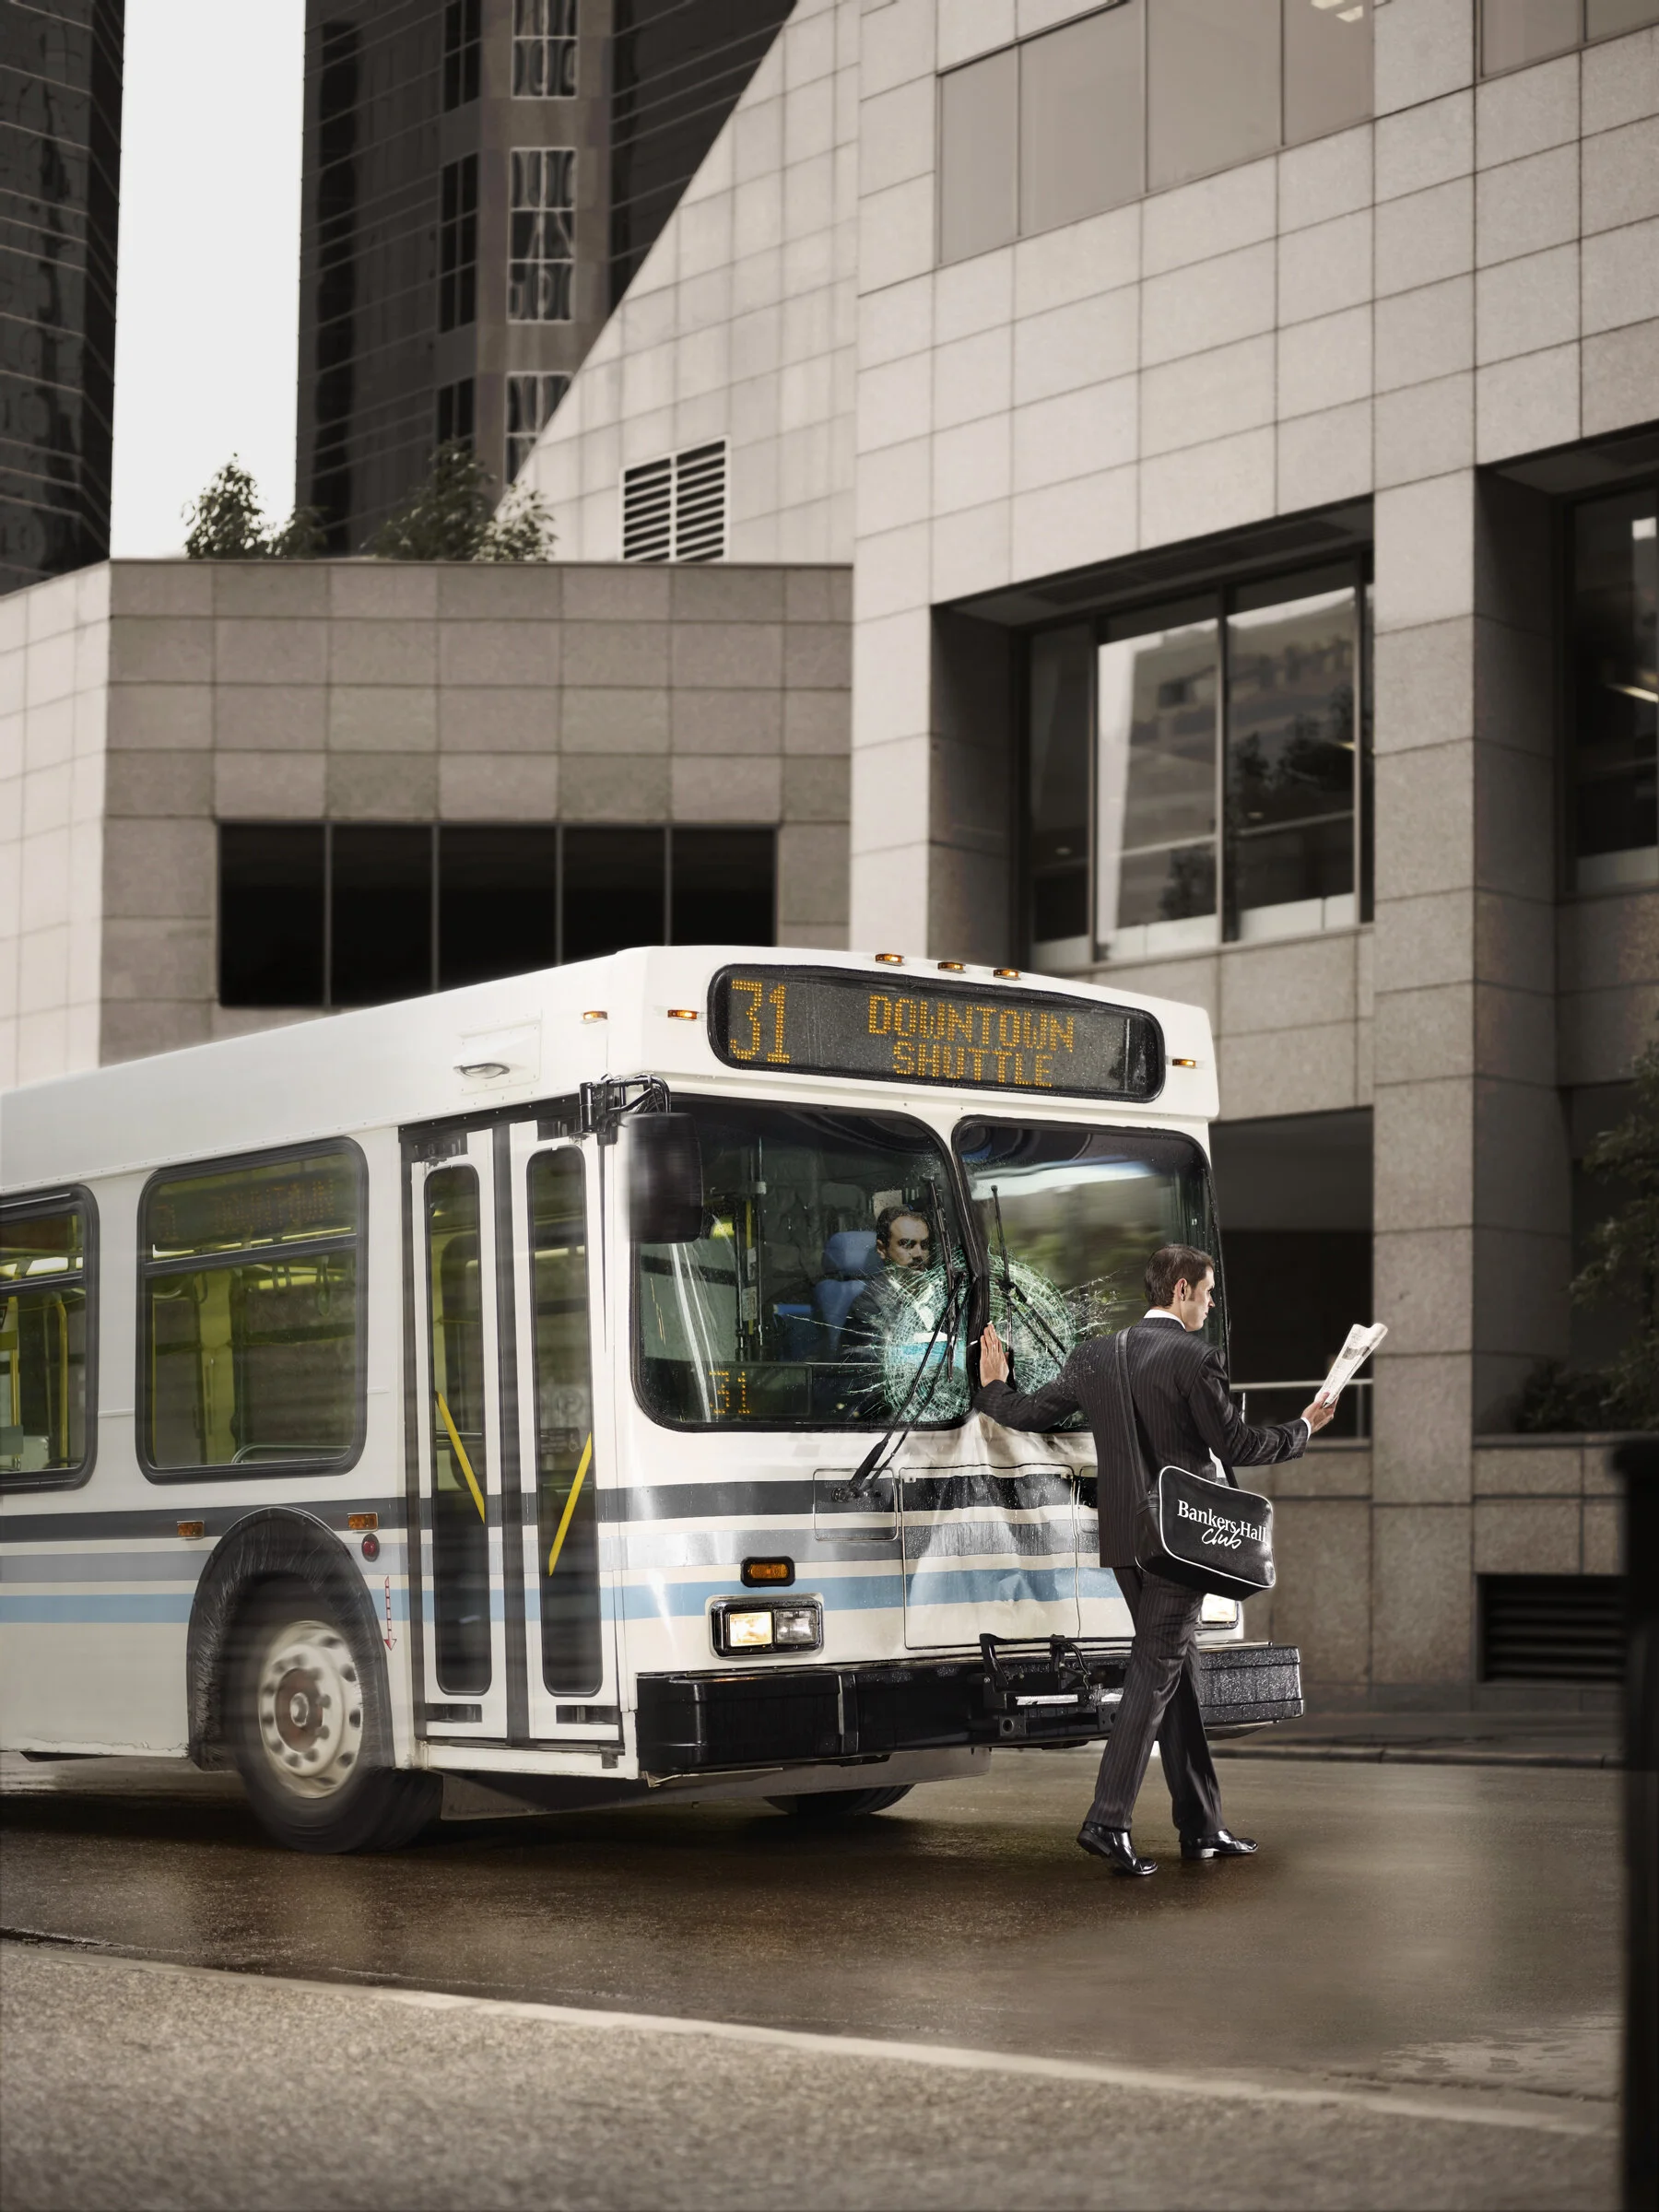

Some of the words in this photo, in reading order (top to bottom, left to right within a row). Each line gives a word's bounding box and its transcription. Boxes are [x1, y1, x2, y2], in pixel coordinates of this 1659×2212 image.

[731, 978, 791, 1065] 31
[868, 994, 1075, 1053] DOWNTOWN
[892, 1041, 1053, 1088] SHUTTLE
[709, 1371, 750, 1414] 31
[1177, 1499, 1237, 1534] Bankers
[1240, 1520, 1267, 1543] Hall
[1202, 1526, 1241, 1549] Club
